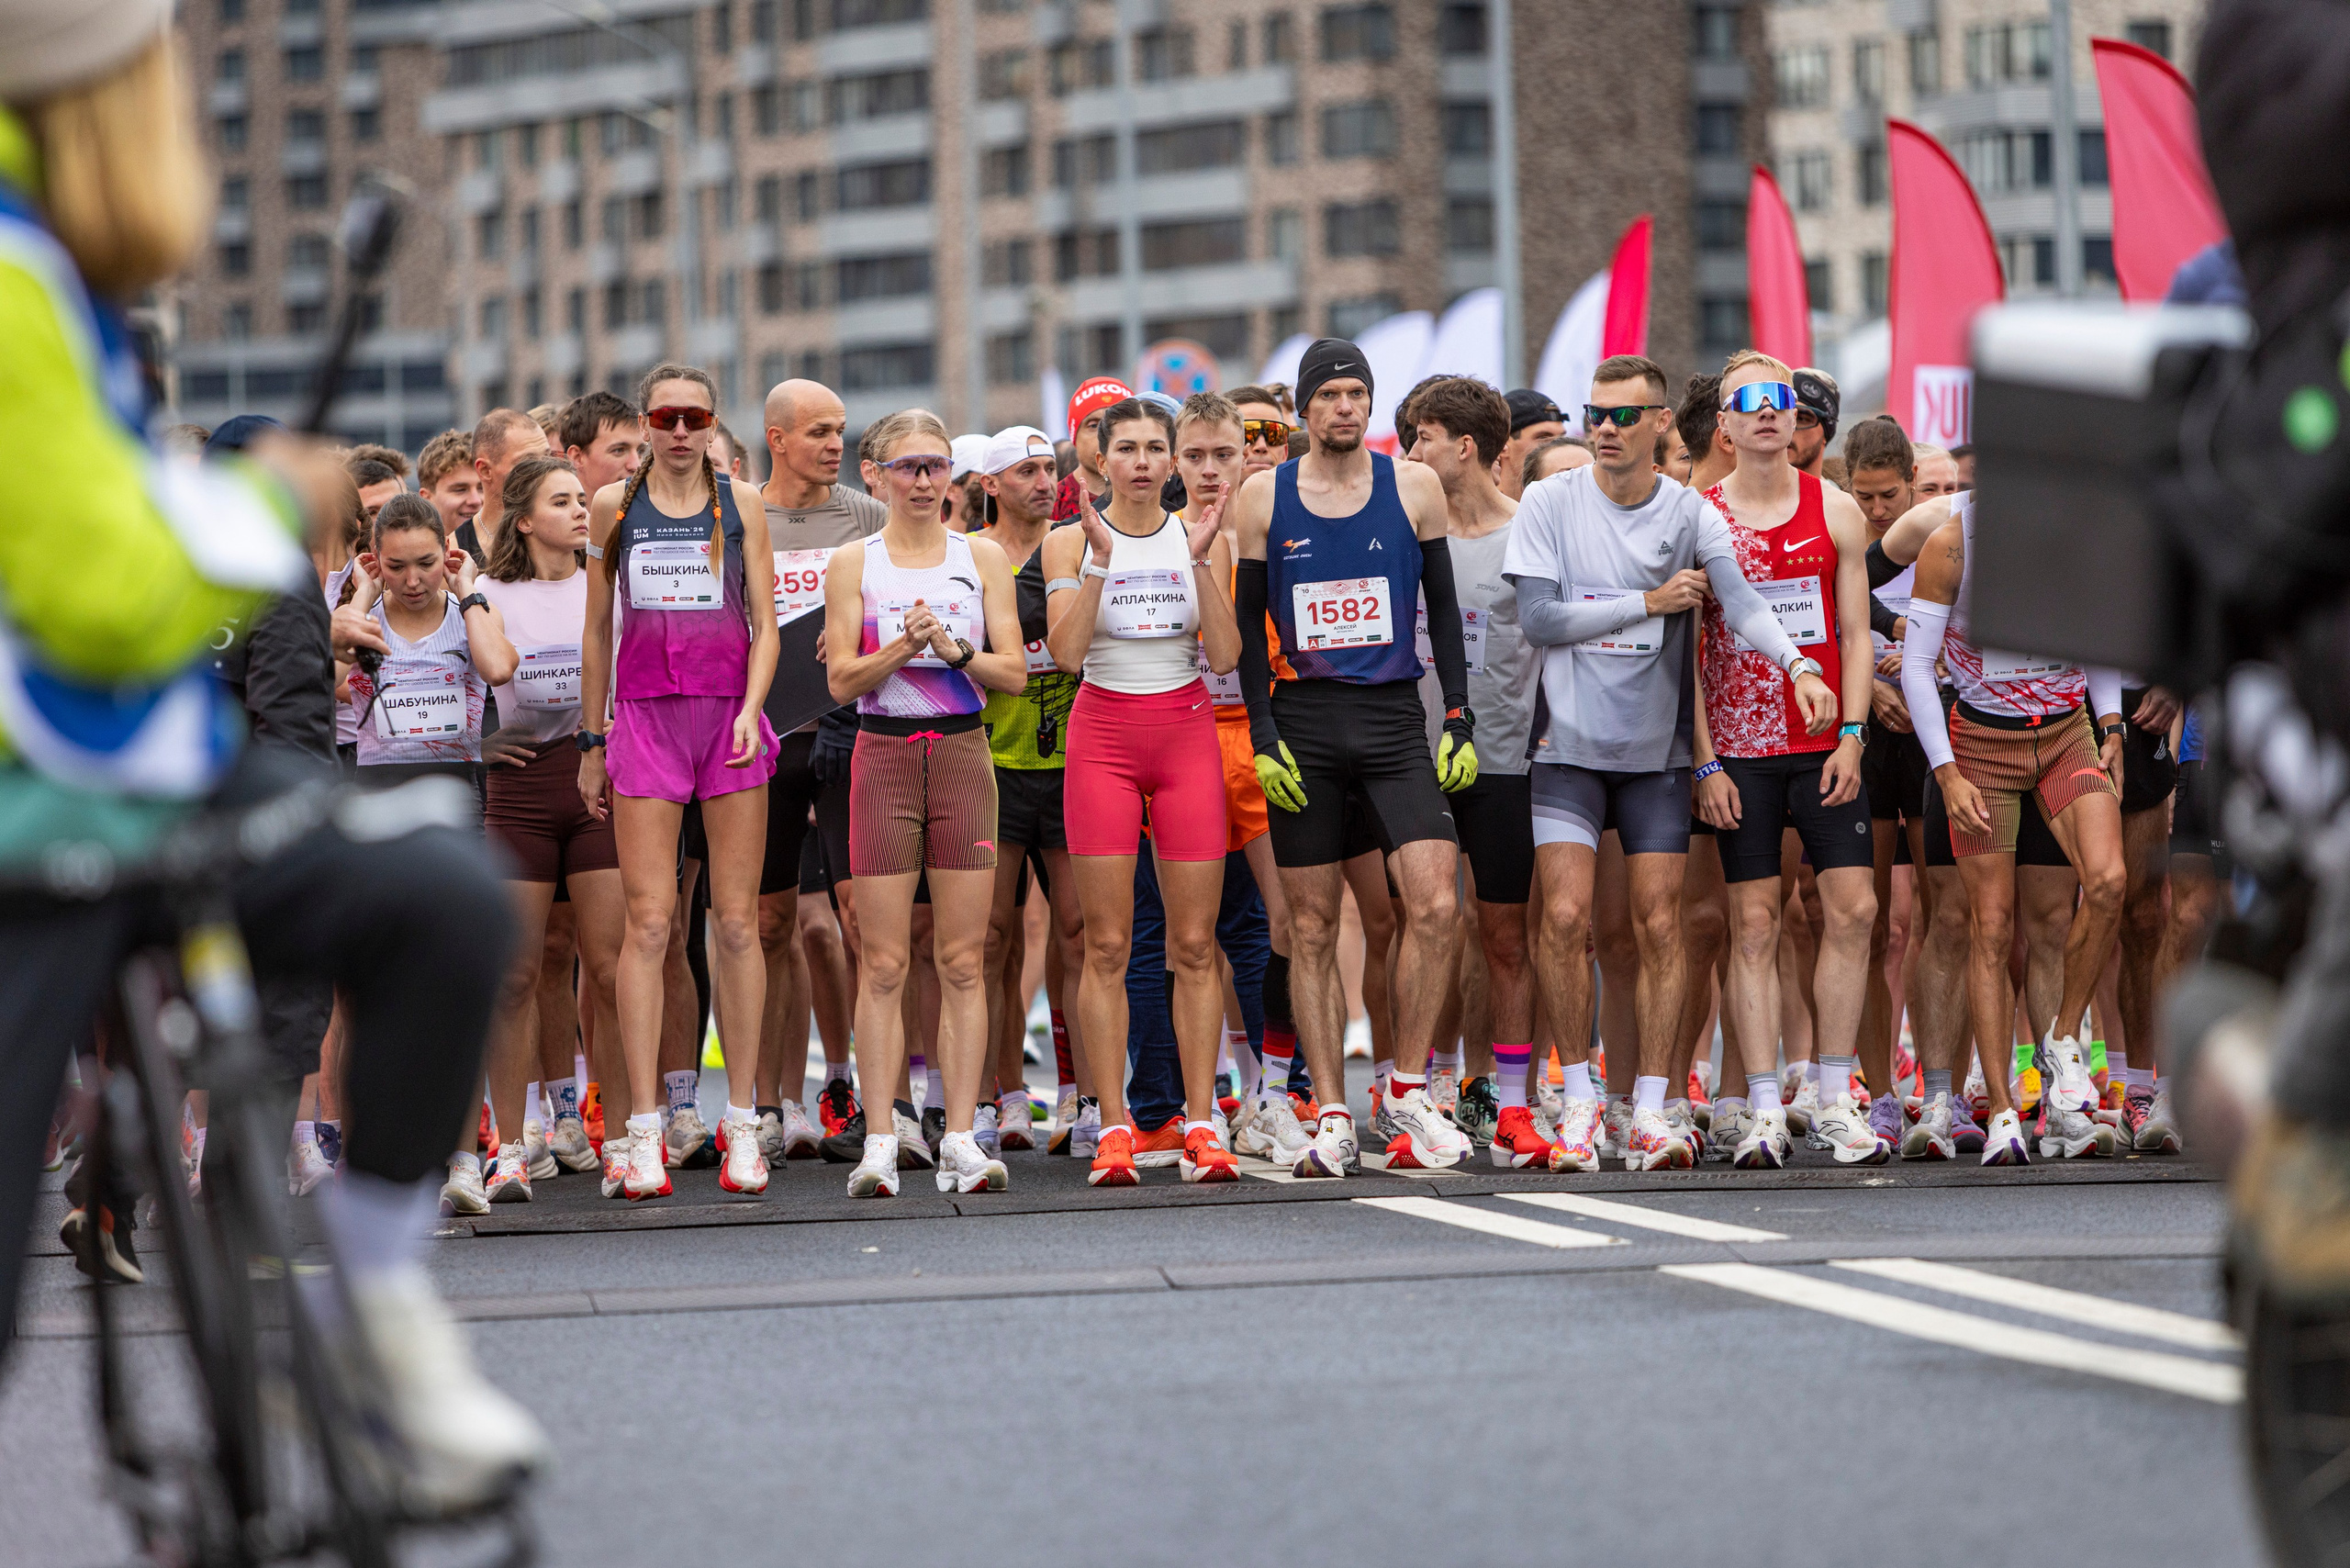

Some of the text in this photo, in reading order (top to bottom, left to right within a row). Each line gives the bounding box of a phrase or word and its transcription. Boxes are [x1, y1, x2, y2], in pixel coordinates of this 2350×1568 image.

[642, 566, 710, 575] БЫШКИНА
[774, 568, 826, 595] 259
[1111, 594, 1186, 605] АПЛАЧКИНА
[1307, 597, 1380, 624] 1582
[1772, 601, 1813, 613] АЛКИН
[385, 694, 458, 708] ШАБУНИНА
